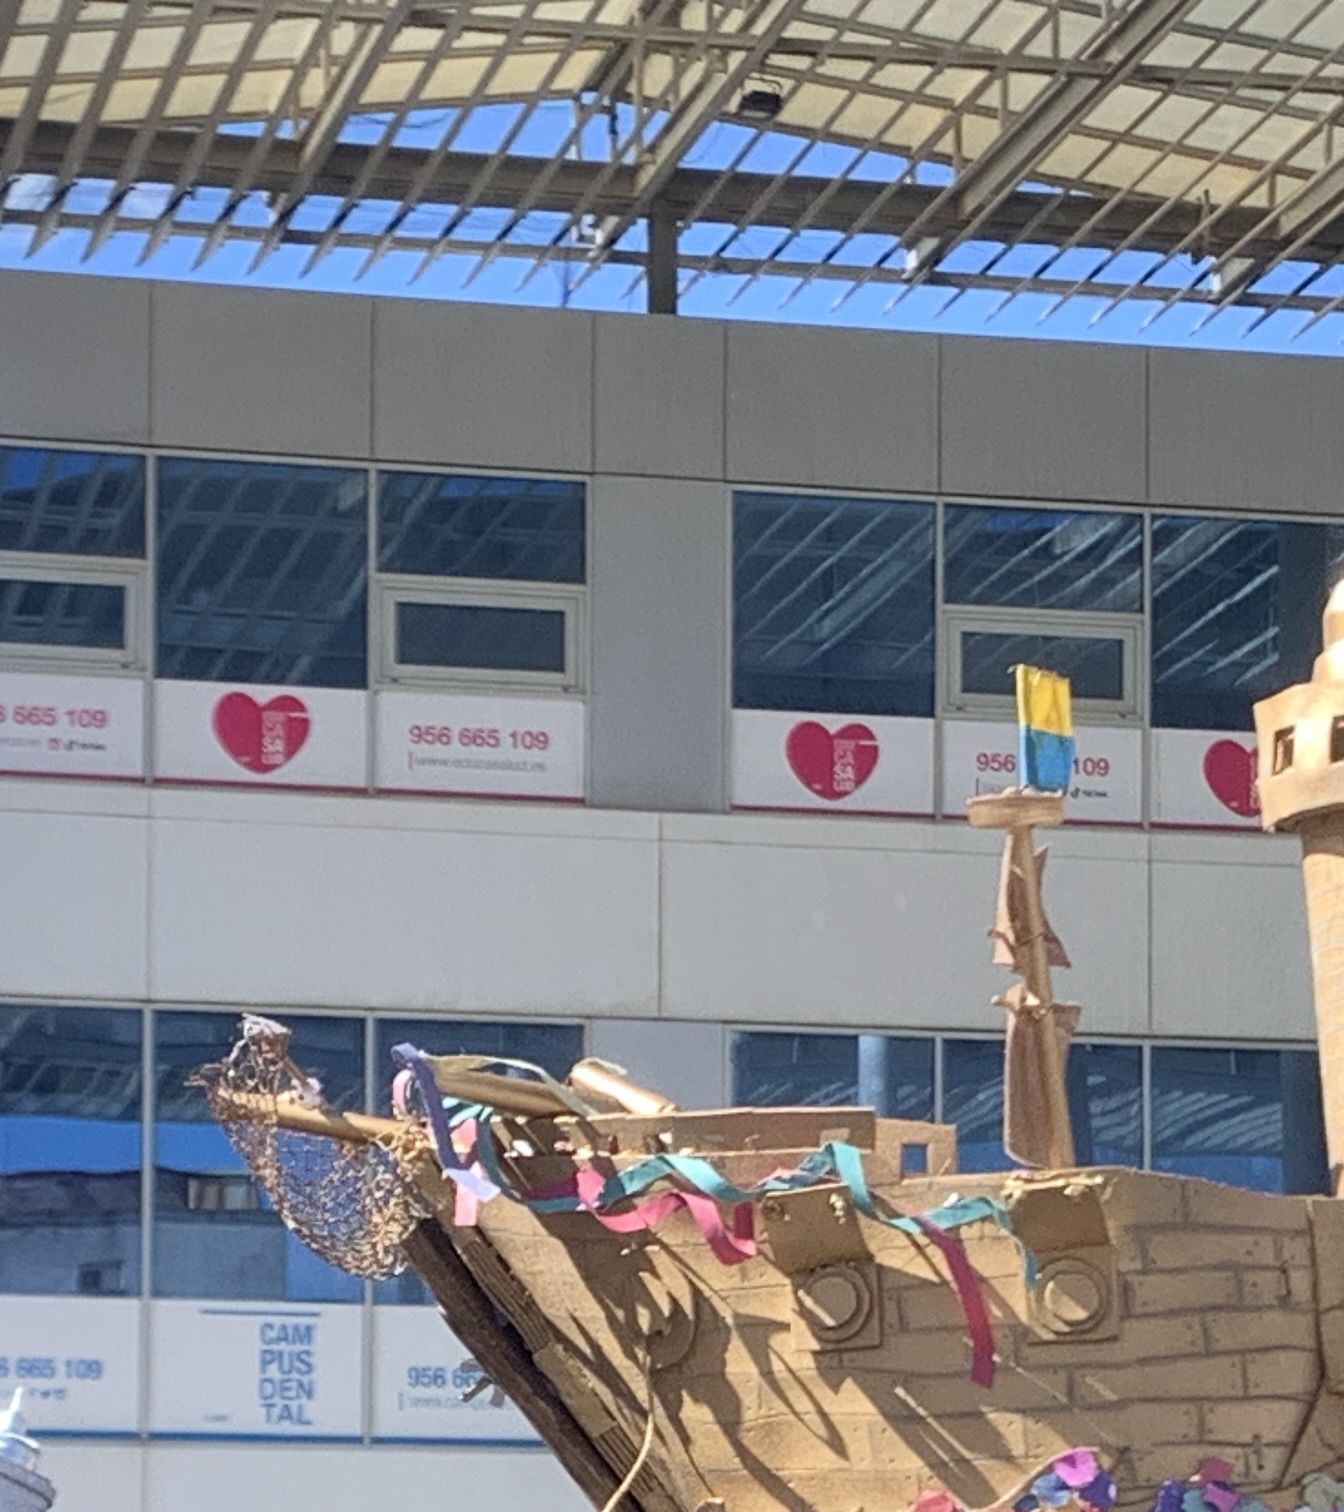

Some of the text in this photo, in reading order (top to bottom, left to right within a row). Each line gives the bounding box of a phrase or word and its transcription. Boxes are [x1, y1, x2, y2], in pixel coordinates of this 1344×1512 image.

[13, 705, 57, 726] 665
[64, 709, 108, 728] 109
[409, 725, 550, 750] 956 665 109
[976, 752, 1110, 776] 956 109
[260, 1322, 315, 1346] CAM
[15, 1357, 56, 1379] 665
[65, 1359, 102, 1380] 109
[260, 1349, 314, 1376] PUS
[259, 1377, 315, 1401] DEN
[408, 1366, 446, 1388] 956
[261, 1402, 313, 1425] TAL
